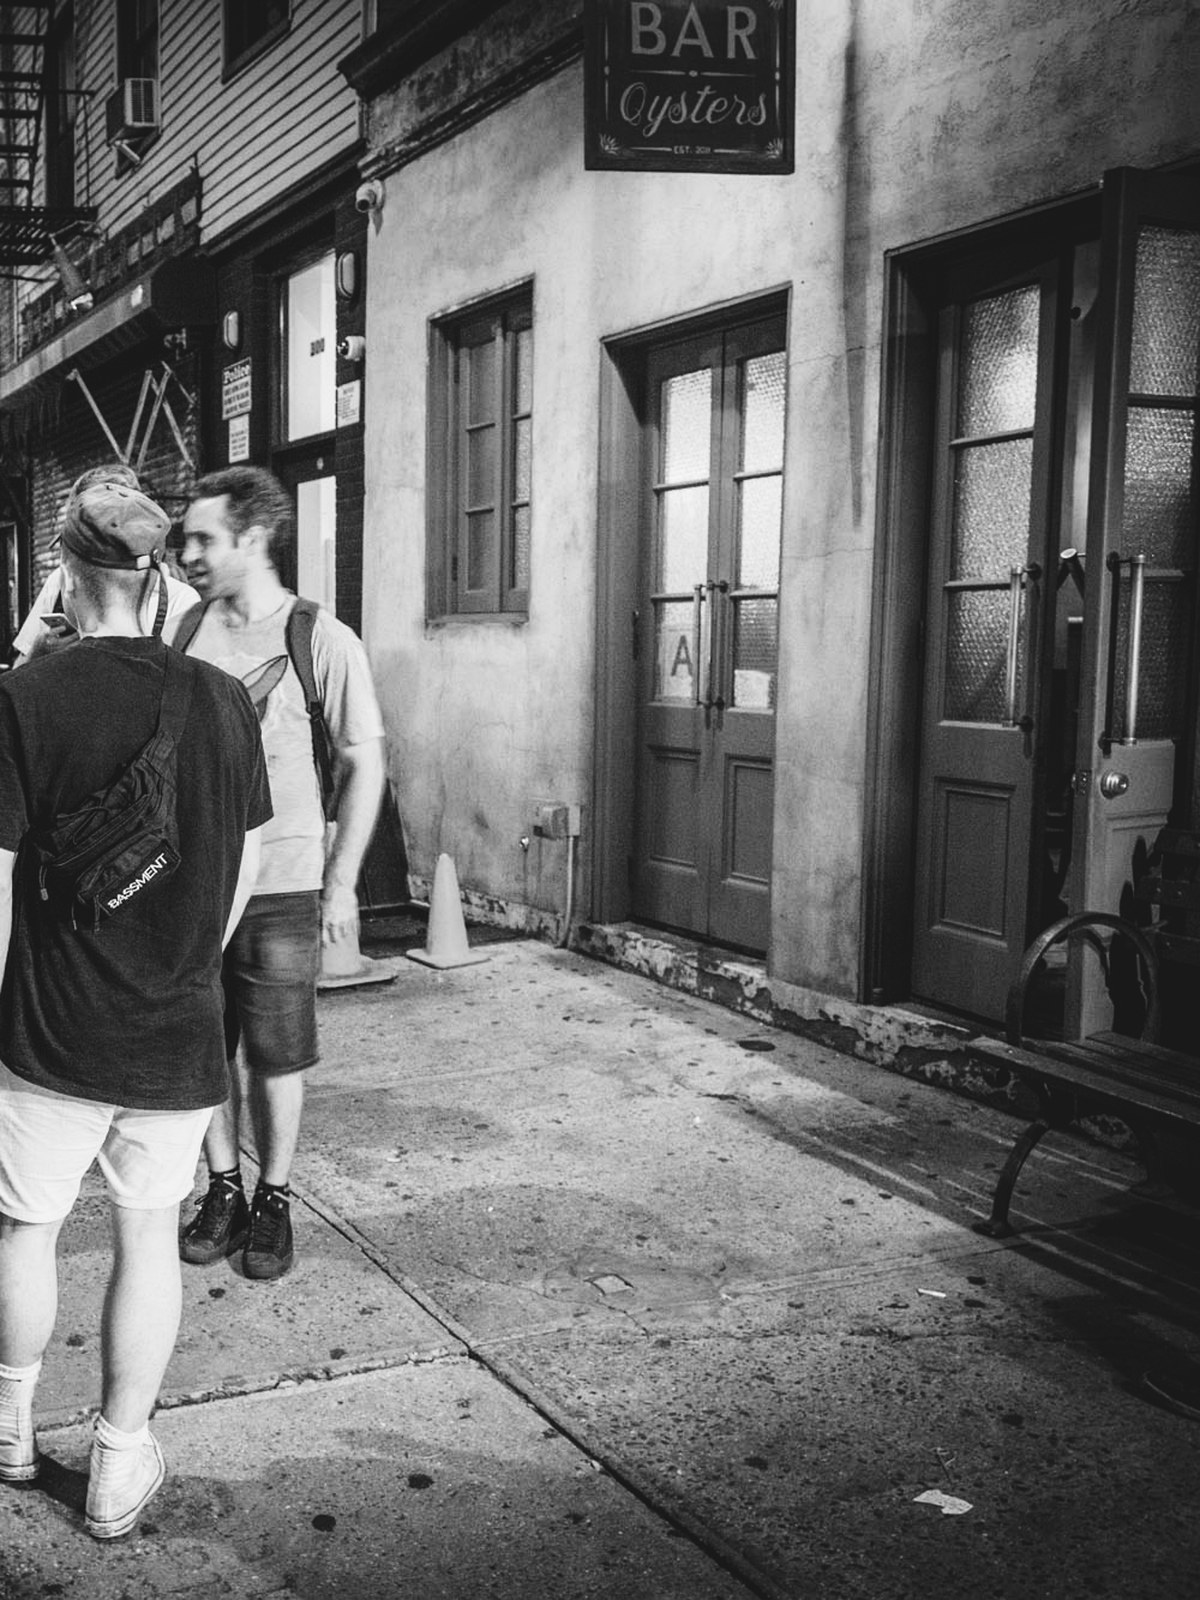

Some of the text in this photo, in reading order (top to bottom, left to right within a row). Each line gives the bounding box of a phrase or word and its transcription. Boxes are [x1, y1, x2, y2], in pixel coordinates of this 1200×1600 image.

[630, 1, 757, 59] BAR
[620, 81, 766, 138] Oysters
[670, 635, 693, 677] A
[107, 852, 168, 909] BASSMENT
